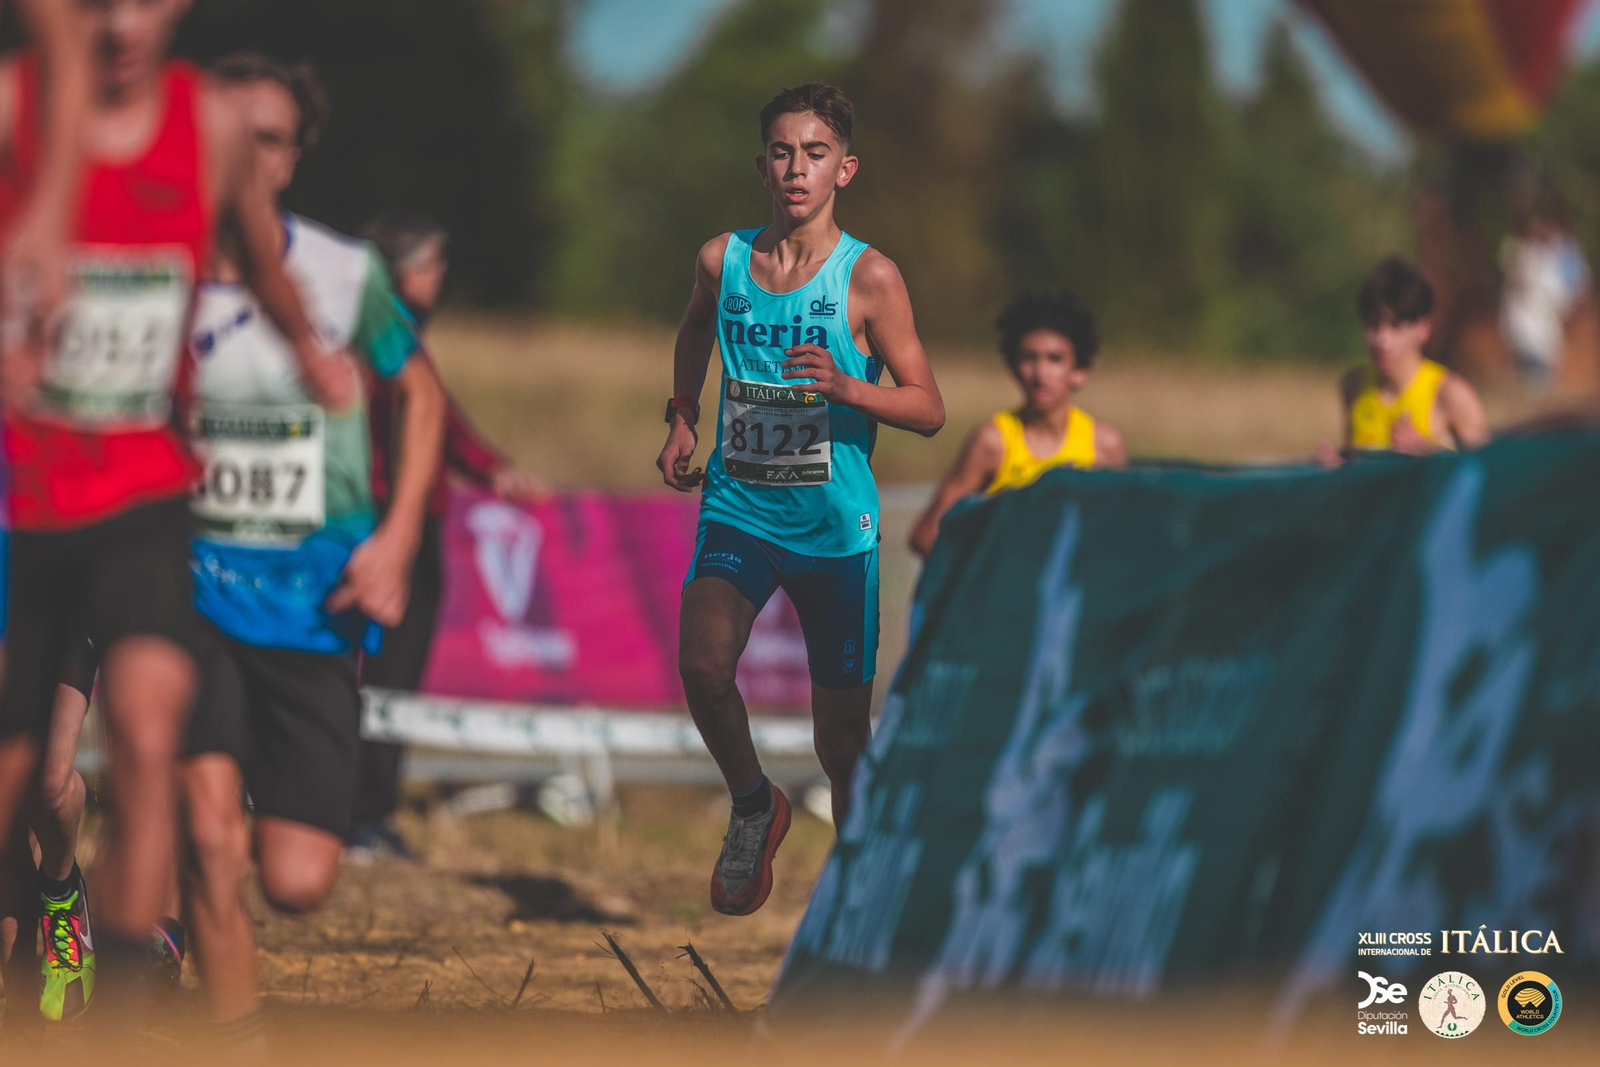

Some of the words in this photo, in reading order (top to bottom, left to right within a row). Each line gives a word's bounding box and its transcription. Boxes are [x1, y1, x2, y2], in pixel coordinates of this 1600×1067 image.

[724, 297, 750, 312] TROPS
[725, 315, 830, 357] nerja
[745, 385, 796, 401] ITÁLICA
[730, 418, 821, 456] 8122
[197, 459, 306, 507] 087
